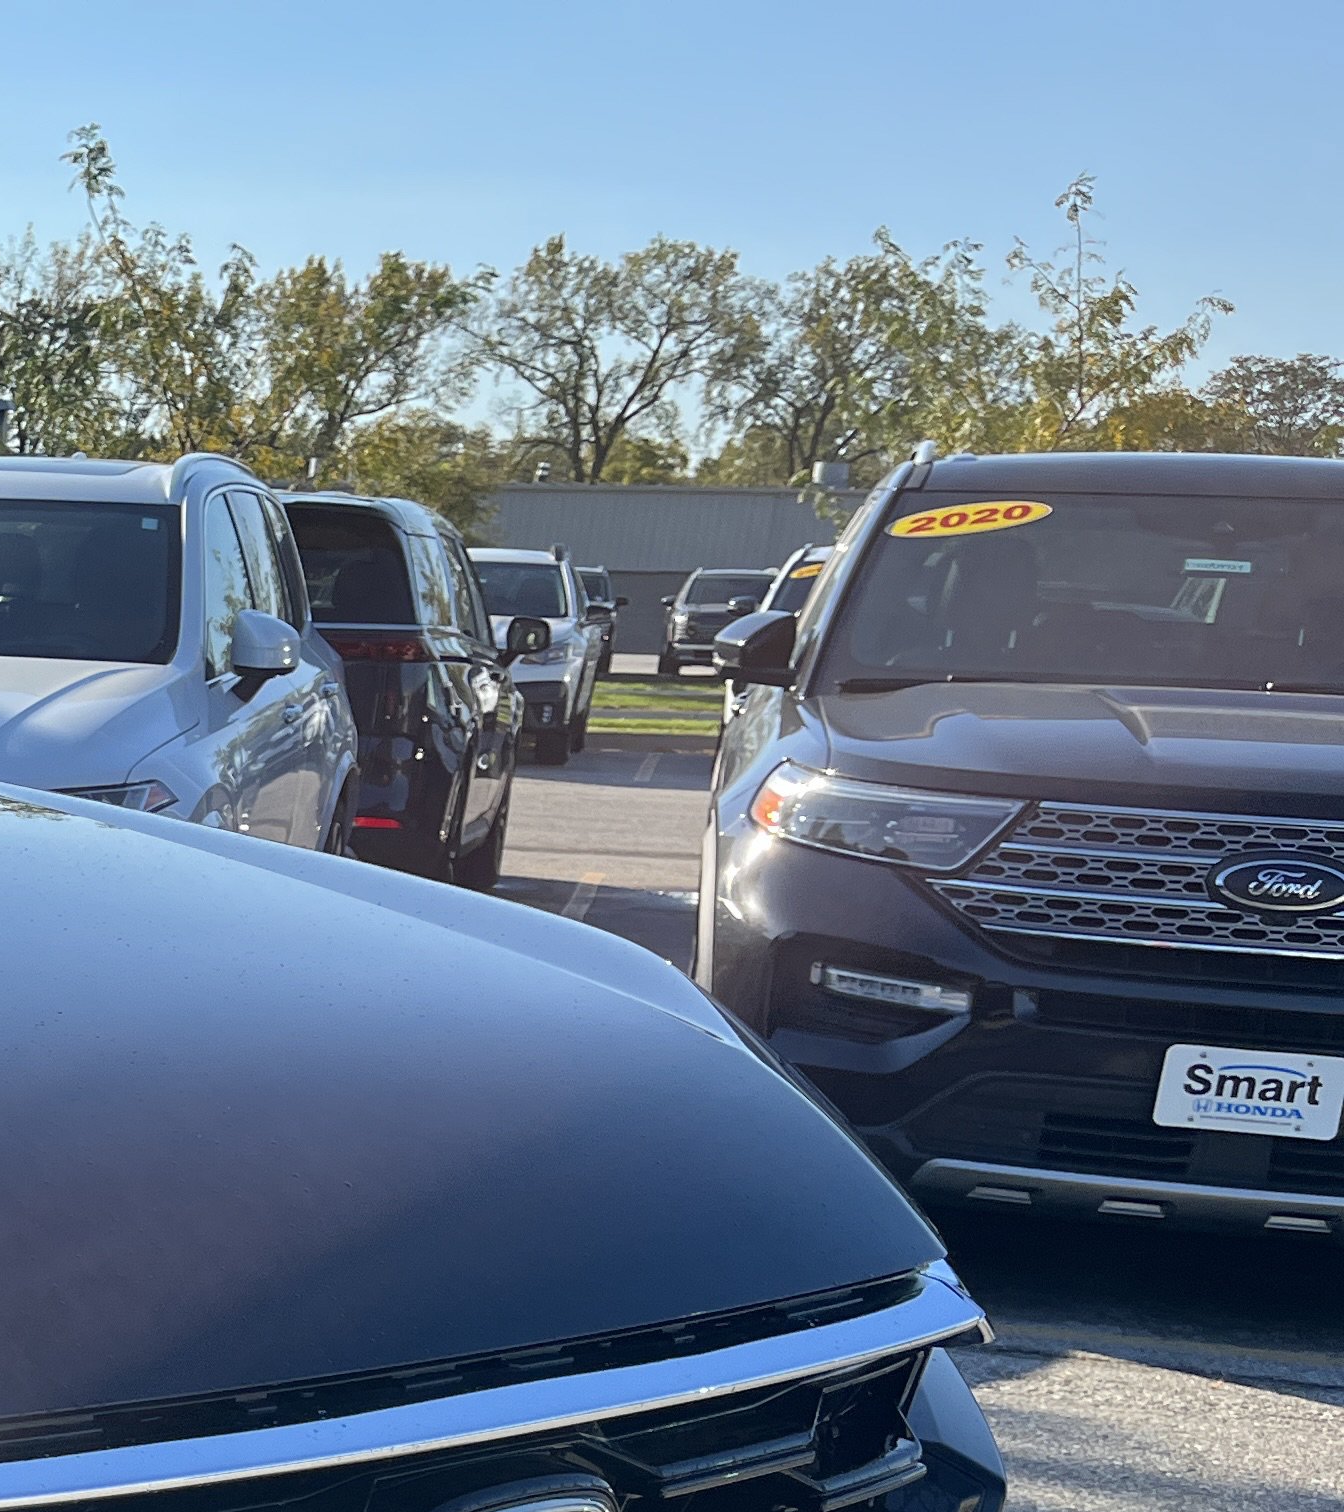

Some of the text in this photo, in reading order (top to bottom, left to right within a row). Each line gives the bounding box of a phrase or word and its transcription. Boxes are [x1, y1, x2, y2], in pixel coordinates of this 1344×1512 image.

[907, 505, 1031, 533] 2020
[1248, 868, 1323, 899] Ford
[1183, 1063, 1323, 1105] Smart
[1215, 1102, 1304, 1120] HONDA
